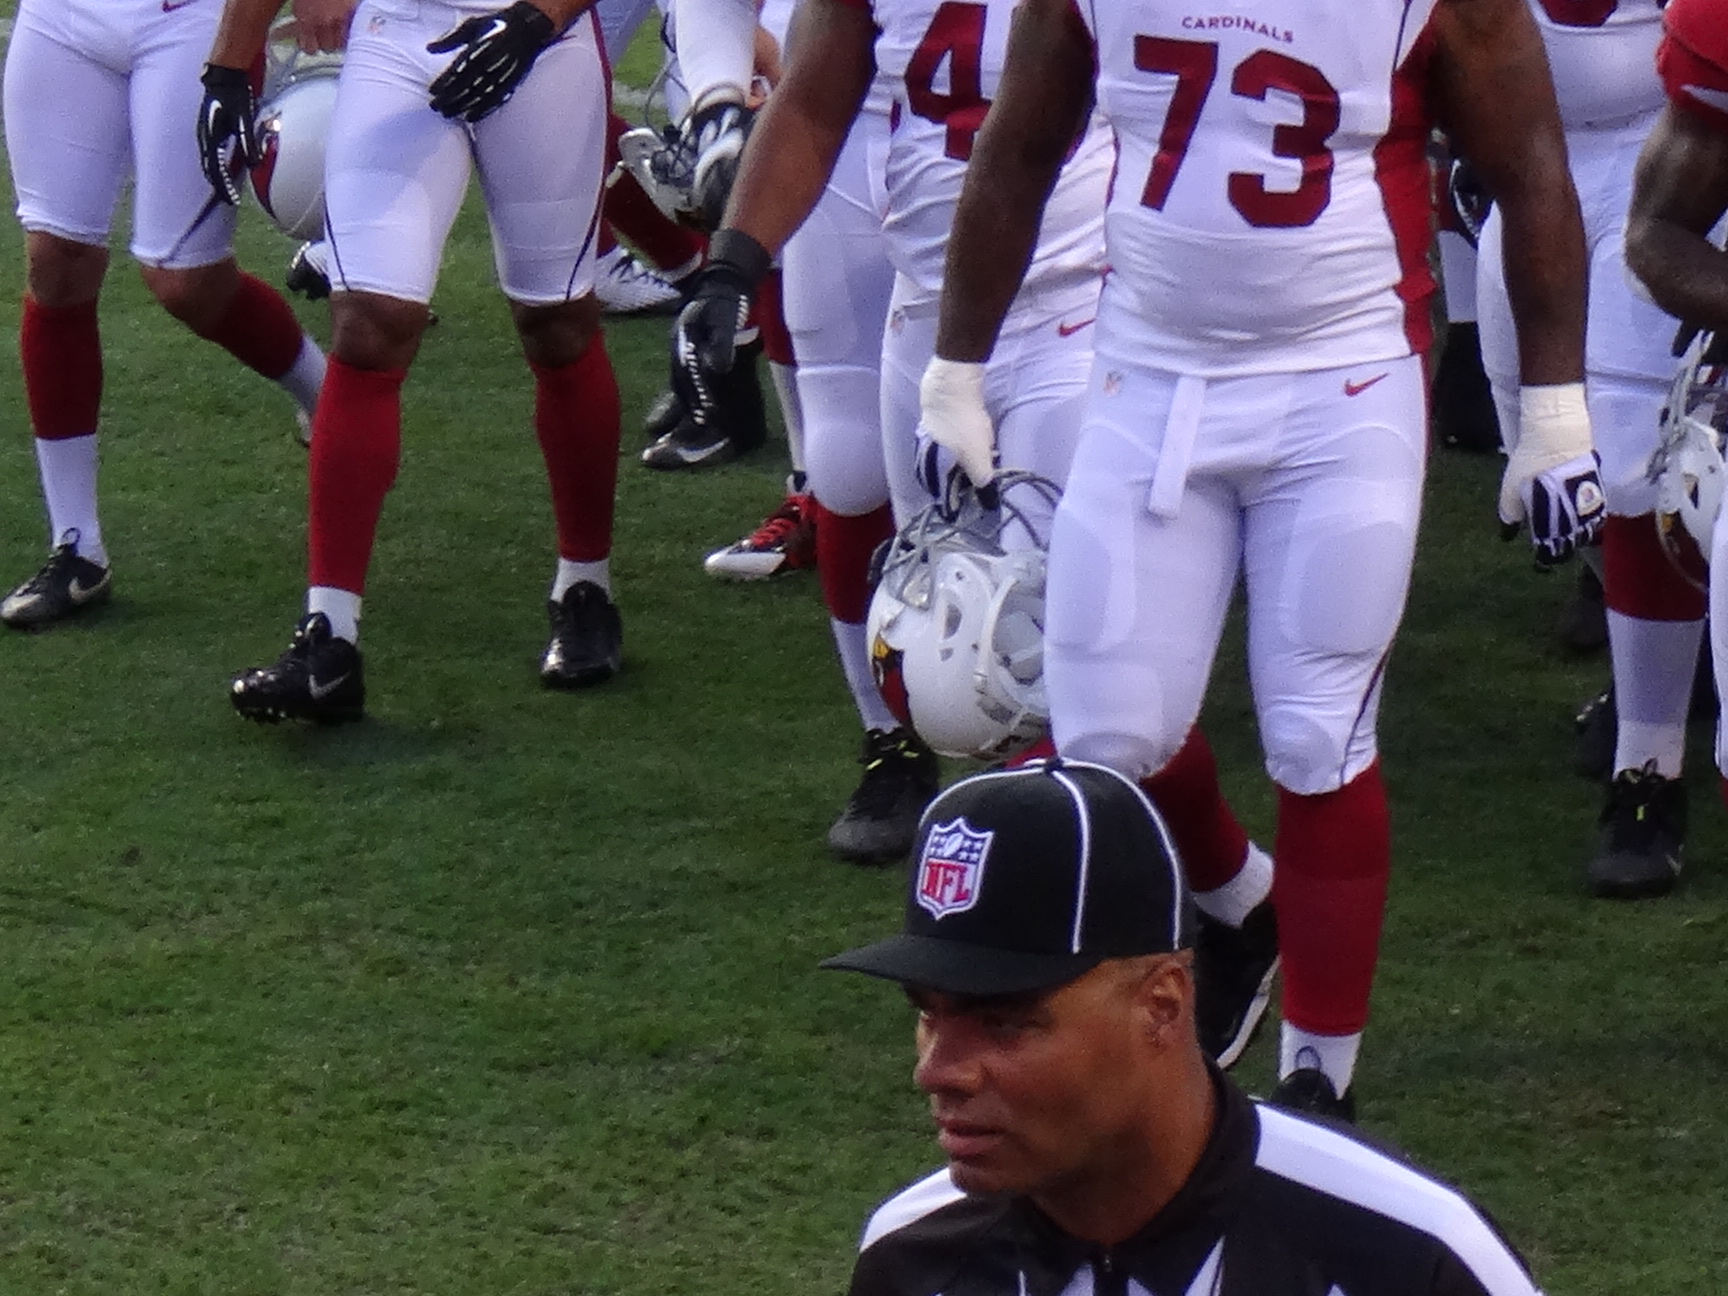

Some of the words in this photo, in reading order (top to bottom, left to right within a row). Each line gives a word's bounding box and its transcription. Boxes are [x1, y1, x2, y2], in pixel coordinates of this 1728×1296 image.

[1181, 16, 1294, 43] CARDINALS
[904, 1, 995, 161] 4
[1134, 34, 1342, 228] 73
[921, 858, 972, 902] NFL
